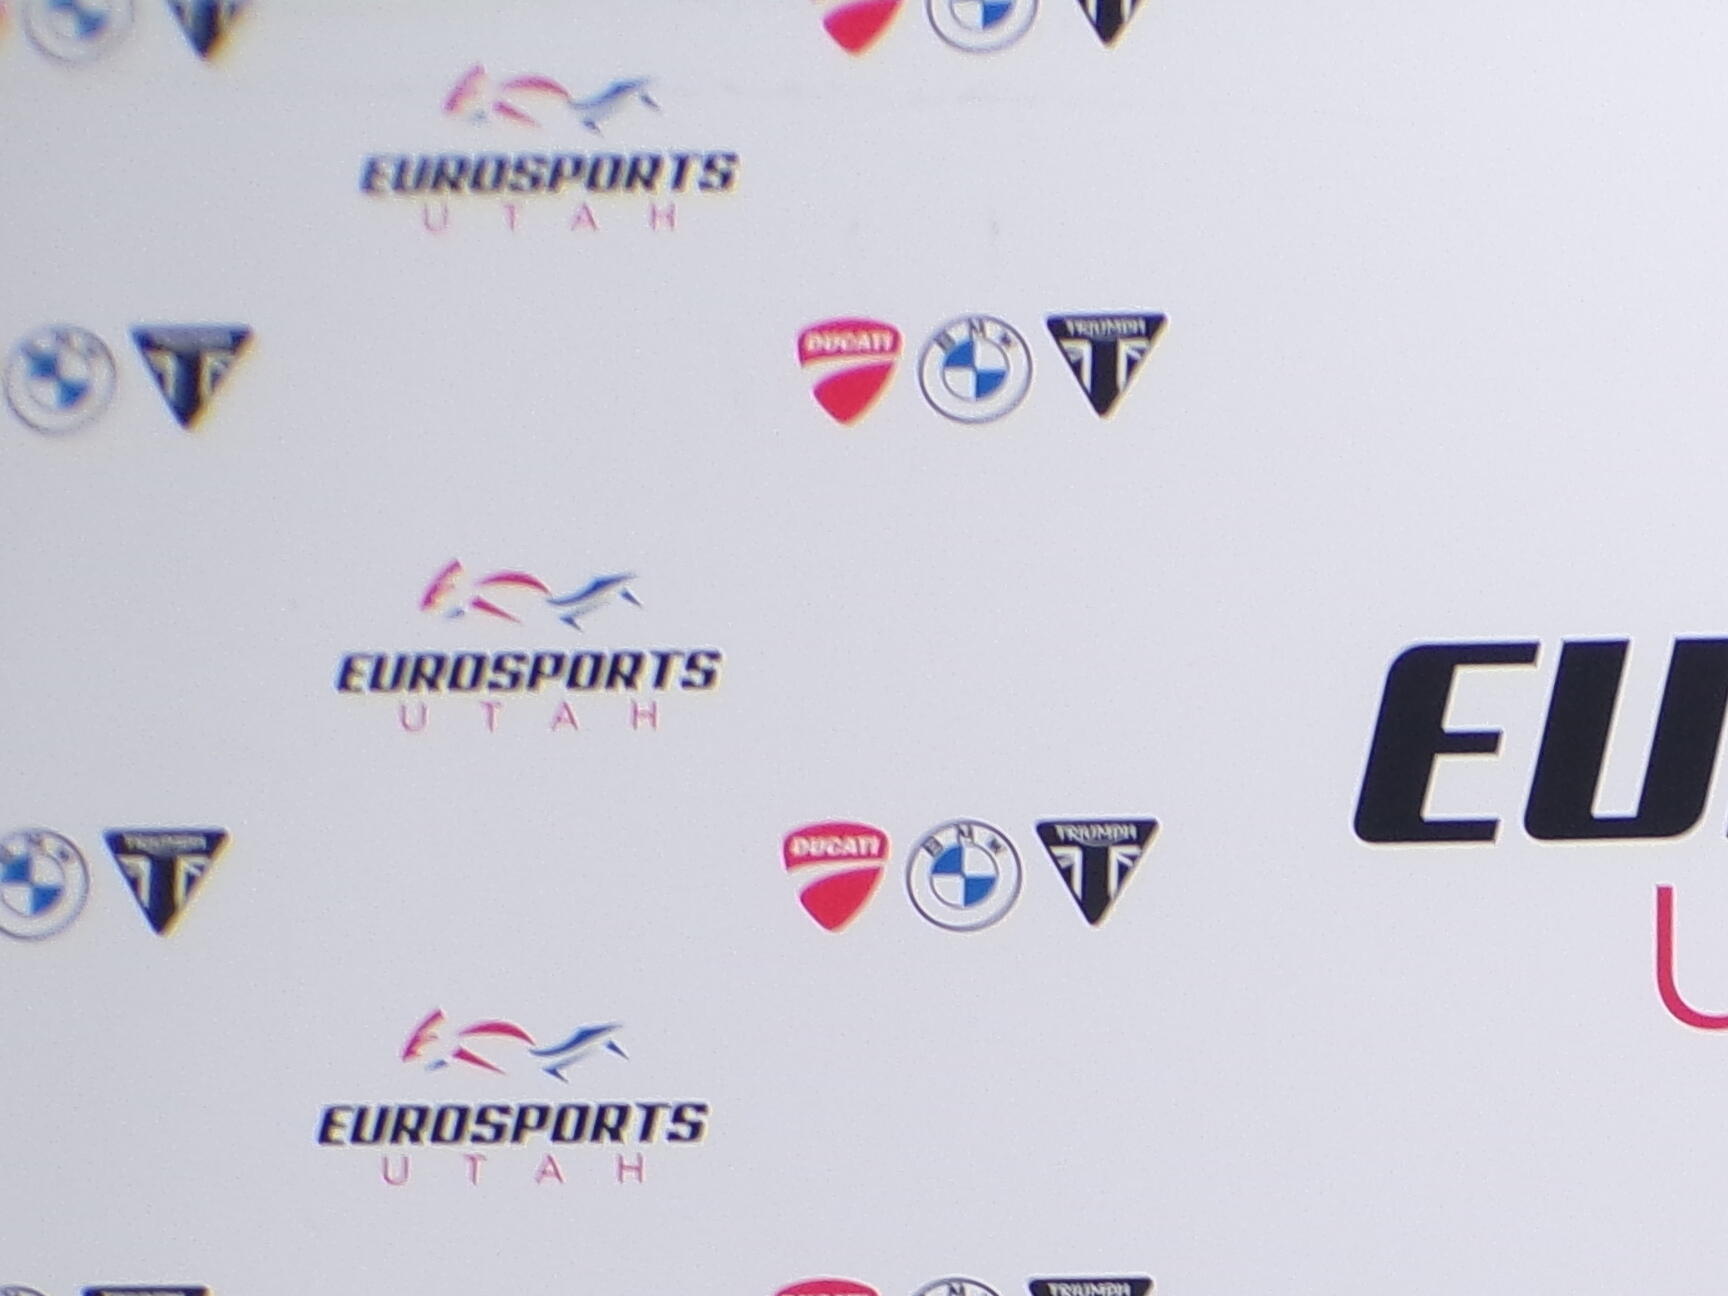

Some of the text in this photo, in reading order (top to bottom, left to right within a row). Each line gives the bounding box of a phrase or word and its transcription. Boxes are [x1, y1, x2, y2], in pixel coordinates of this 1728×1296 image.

[362, 154, 737, 194] EUROSPORTS
[423, 202, 678, 234] UTAH
[806, 330, 893, 354] DUCATI
[1063, 318, 1147, 338] TRIUMPH
[338, 652, 720, 692] EUROSPORTS
[398, 700, 659, 733] UTAH
[790, 834, 879, 858] DUCATI
[1054, 823, 1136, 842] TRIUMPH
[318, 1104, 707, 1144] EUROSPORTS
[380, 1154, 646, 1186] UTAH
